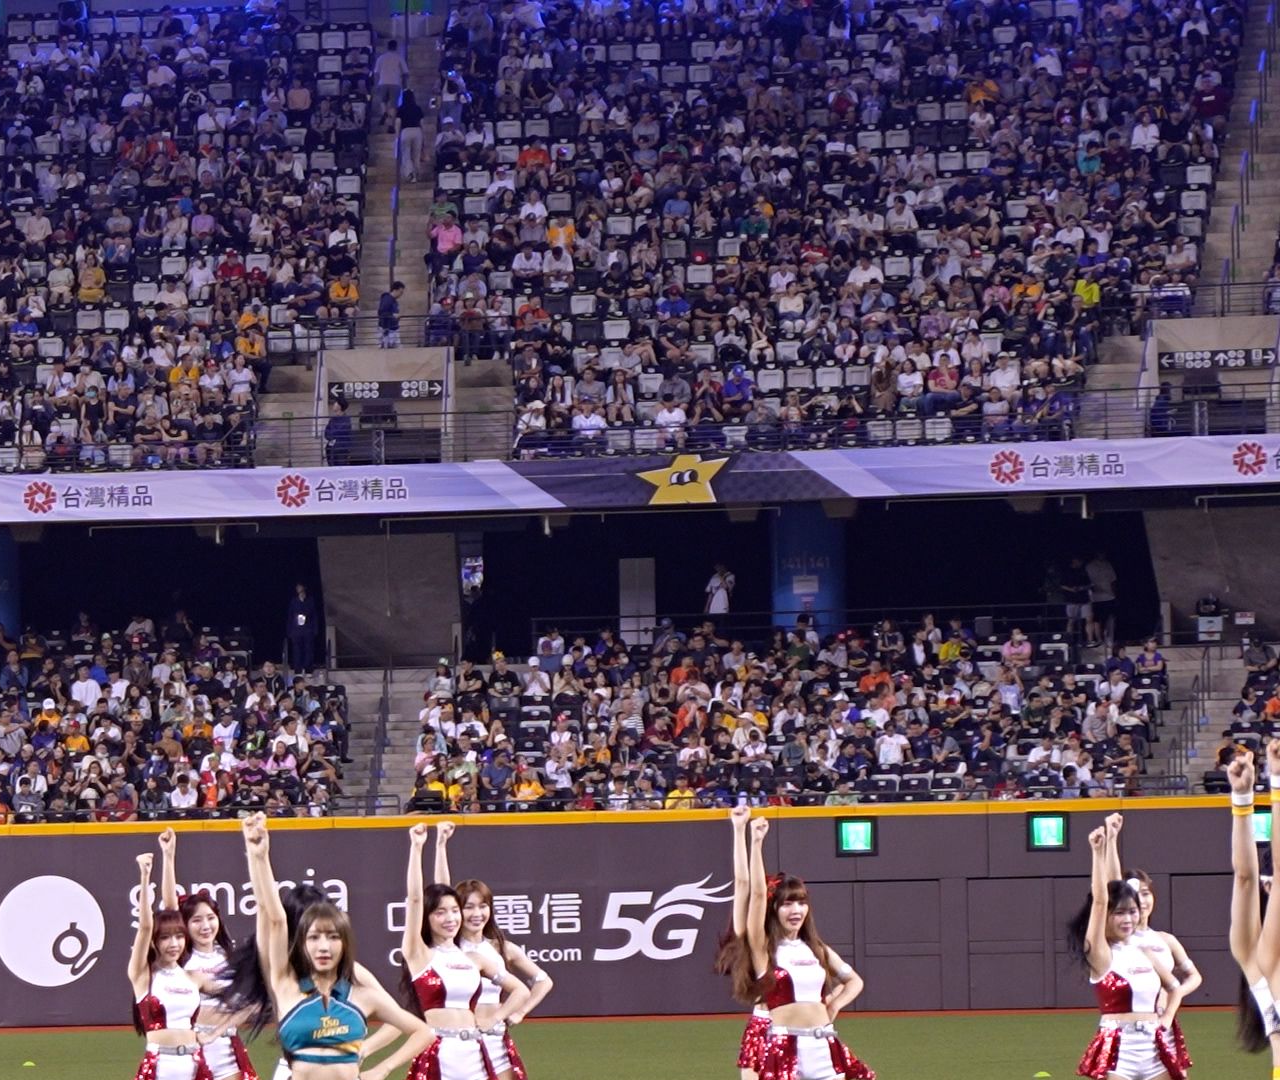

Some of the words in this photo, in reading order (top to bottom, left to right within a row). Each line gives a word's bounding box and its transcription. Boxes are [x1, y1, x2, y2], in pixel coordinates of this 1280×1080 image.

[1030, 453, 1124, 478] 台灣精品
[61, 485, 153, 509] 台灣精品
[315, 478, 407, 502] 台灣精品
[130, 868, 348, 928] gmaia
[593, 891, 704, 961] 5G
